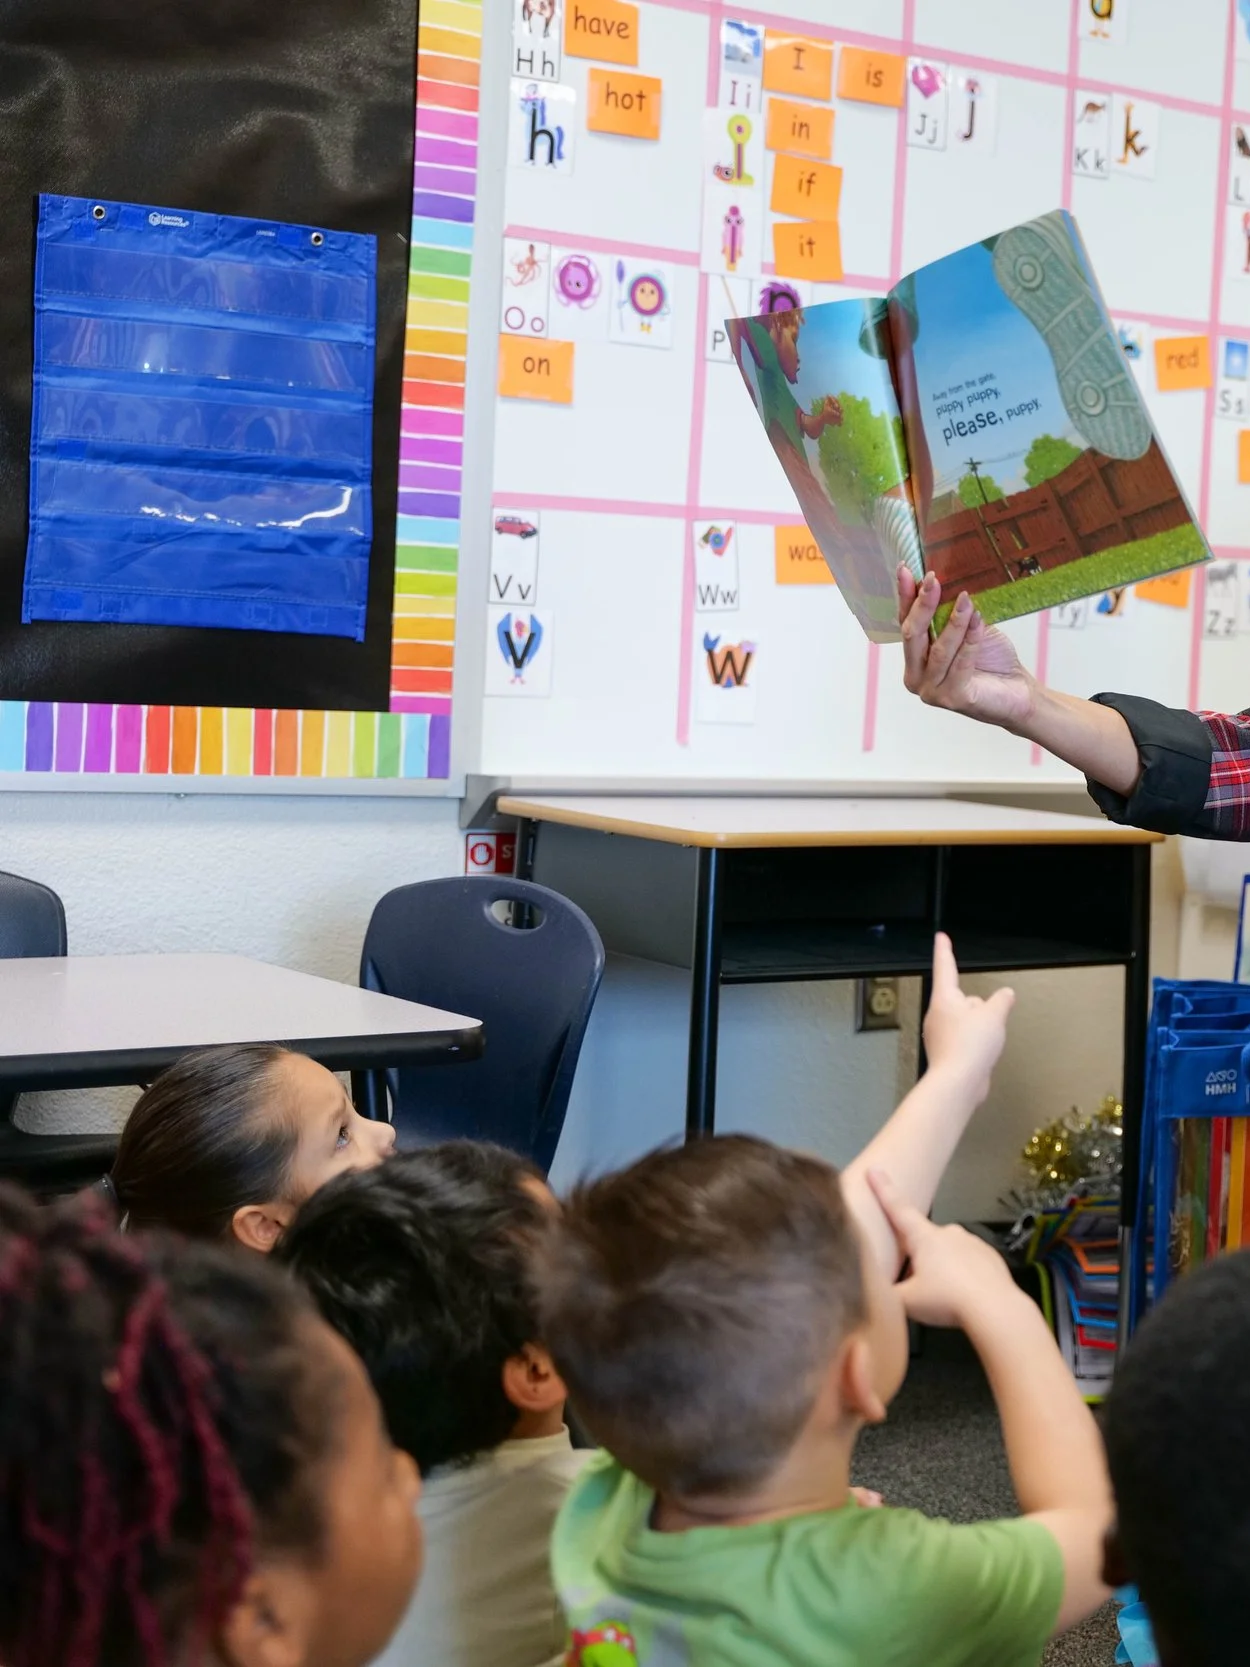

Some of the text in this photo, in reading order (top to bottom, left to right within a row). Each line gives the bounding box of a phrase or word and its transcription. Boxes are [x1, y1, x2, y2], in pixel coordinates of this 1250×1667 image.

[573, 5, 630, 39] have
[793, 48, 806, 71] I
[865, 63, 884, 88] is
[605, 81, 647, 112] hot
[790, 115, 811, 141] in
[797, 172, 816, 197] if
[798, 236, 816, 258] it
[522, 356, 551, 376] on
[1165, 346, 1200, 371] red
[942, 409, 1004, 446] please,
[1205, 1082, 1237, 1096] HMH
